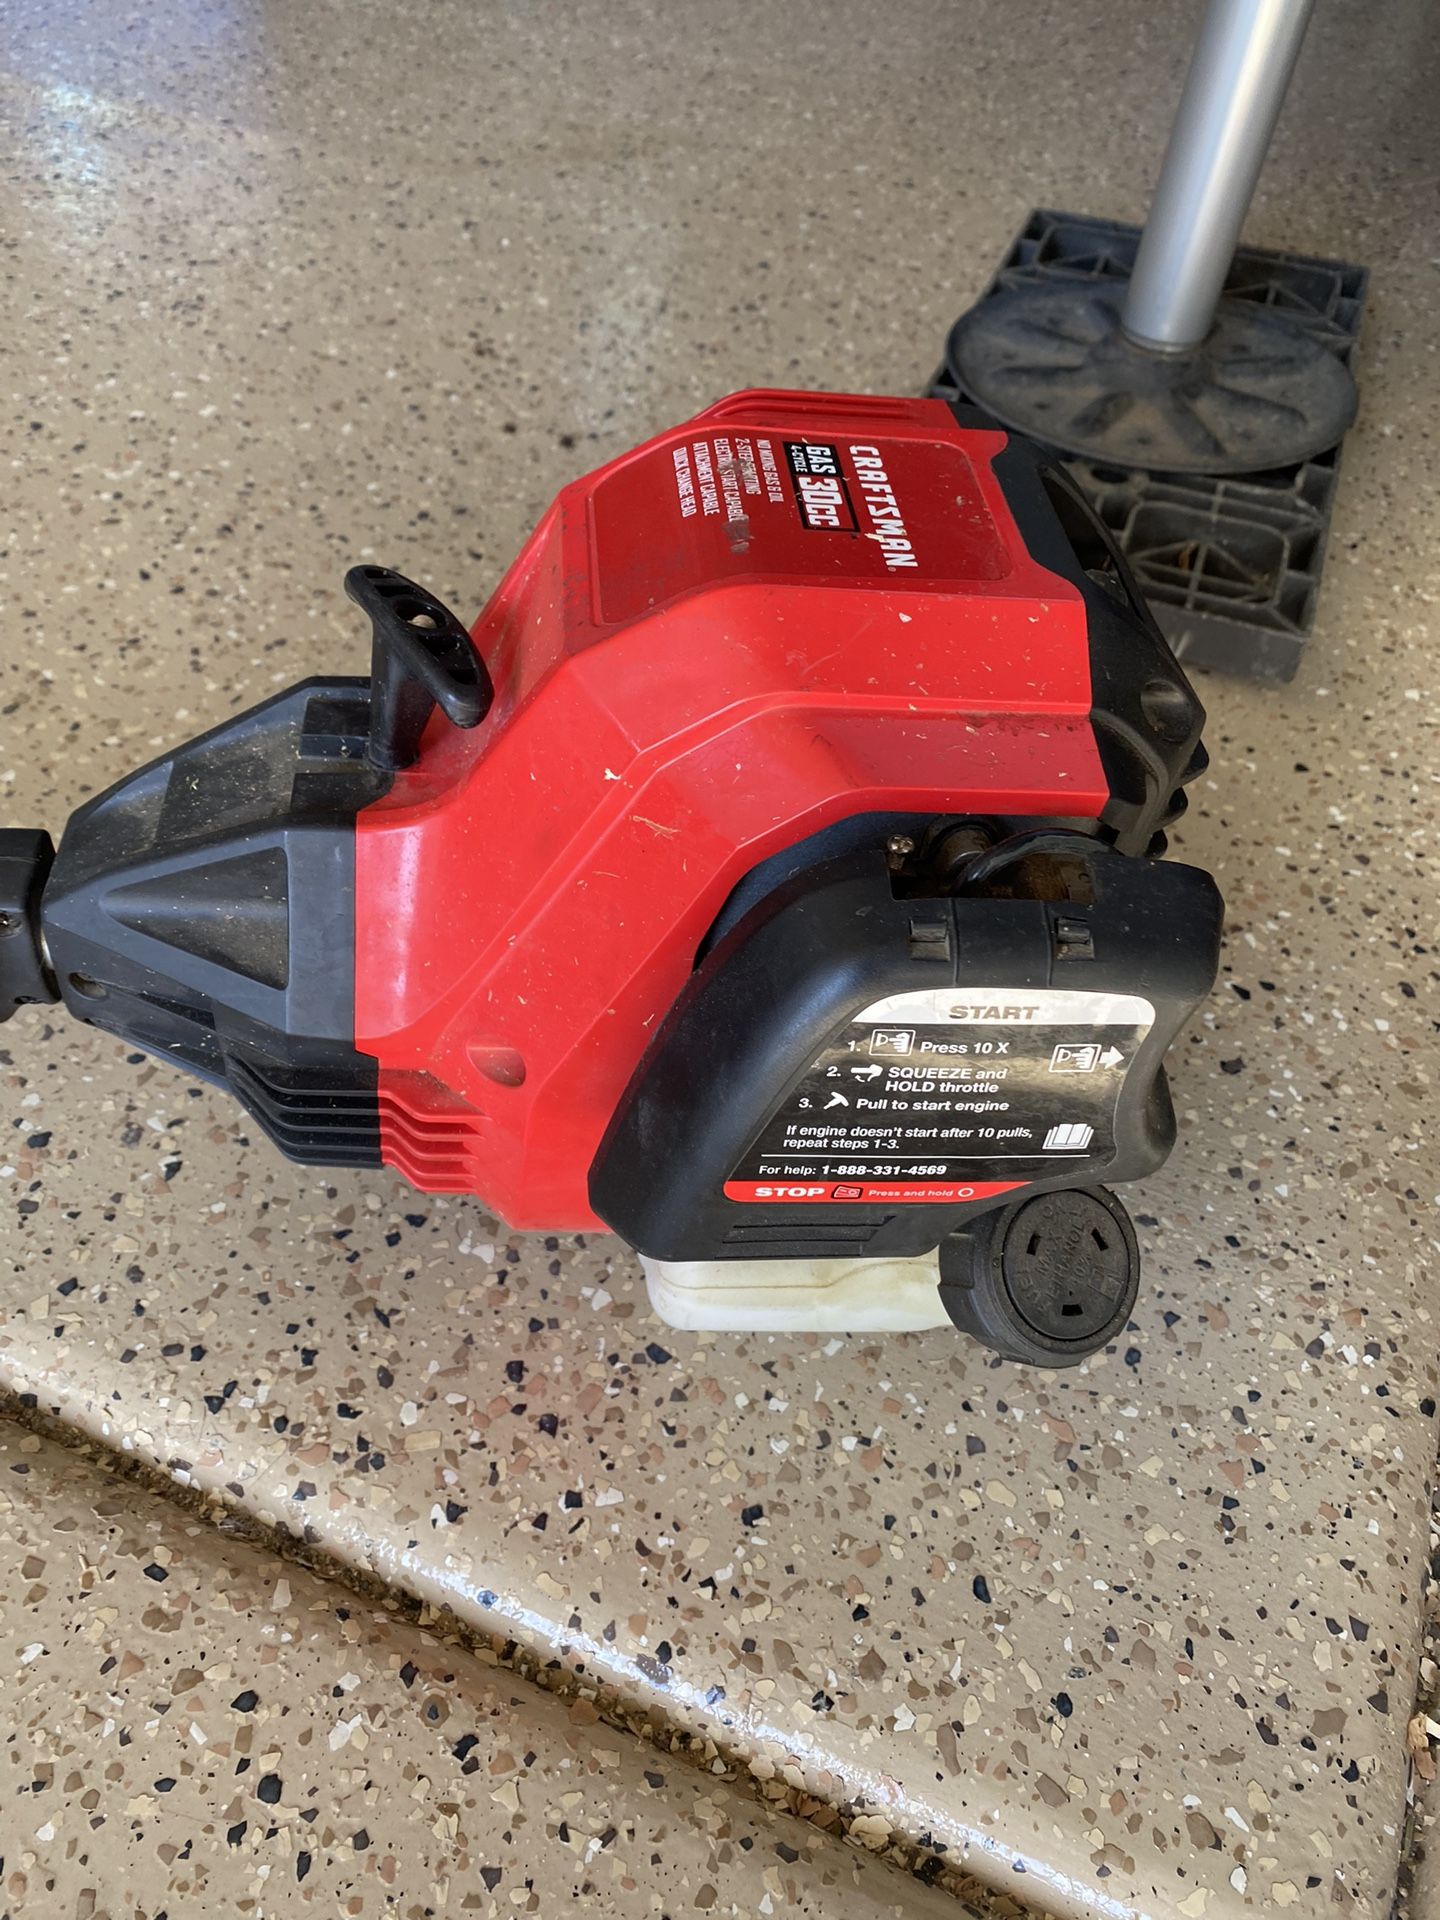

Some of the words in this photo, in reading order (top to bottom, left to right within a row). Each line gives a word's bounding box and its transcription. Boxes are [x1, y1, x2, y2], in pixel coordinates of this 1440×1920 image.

[790, 445, 808, 473] 4-CYCLE
[806, 446, 837, 475] GAS
[676, 468, 694, 498] CHANGE
[764, 471, 780, 486] GAS
[680, 495, 697, 518] HEAD
[700, 483, 720, 516] CAPABLE
[849, 445, 918, 568] CRAFTSMAN
[949, 1006, 1039, 1021] START
[848, 1041, 861, 1052] 1.
[920, 1041, 968, 1054] Press
[973, 1042, 993, 1054] 10
[995, 1042, 1010, 1054] X
[826, 1067, 842, 1077] 2.
[888, 1067, 972, 1080] SQUEEZE
[976, 1068, 1008, 1080] and
[885, 1081, 935, 1093] HOLD
[939, 1081, 1000, 1094] throttle
[798, 1098, 813, 1108] 3.
[856, 1098, 887, 1110] Pull
[891, 1100, 909, 1110] to
[912, 1100, 952, 1111] start
[954, 1101, 1010, 1113] engine
[786, 1125, 798, 1136] If
[799, 1125, 847, 1138] engine
[850, 1126, 903, 1138] doesn't
[905, 1127, 938, 1138] start
[940, 1128, 974, 1138] after
[977, 1128, 995, 1138] 10
[996, 1127, 1033, 1140] pulls,
[783, 1138, 829, 1149] repeat
[831, 1138, 870, 1150] steps
[874, 1139, 900, 1149] 1-3.
[759, 1165, 781, 1175] For
[784, 1165, 817, 1176] help:
[822, 1165, 947, 1176] 1-888-331-4569
[755, 1187, 825, 1197] STOP
[868, 1189, 900, 1197] Press
[927, 1189, 954, 1197] hold
